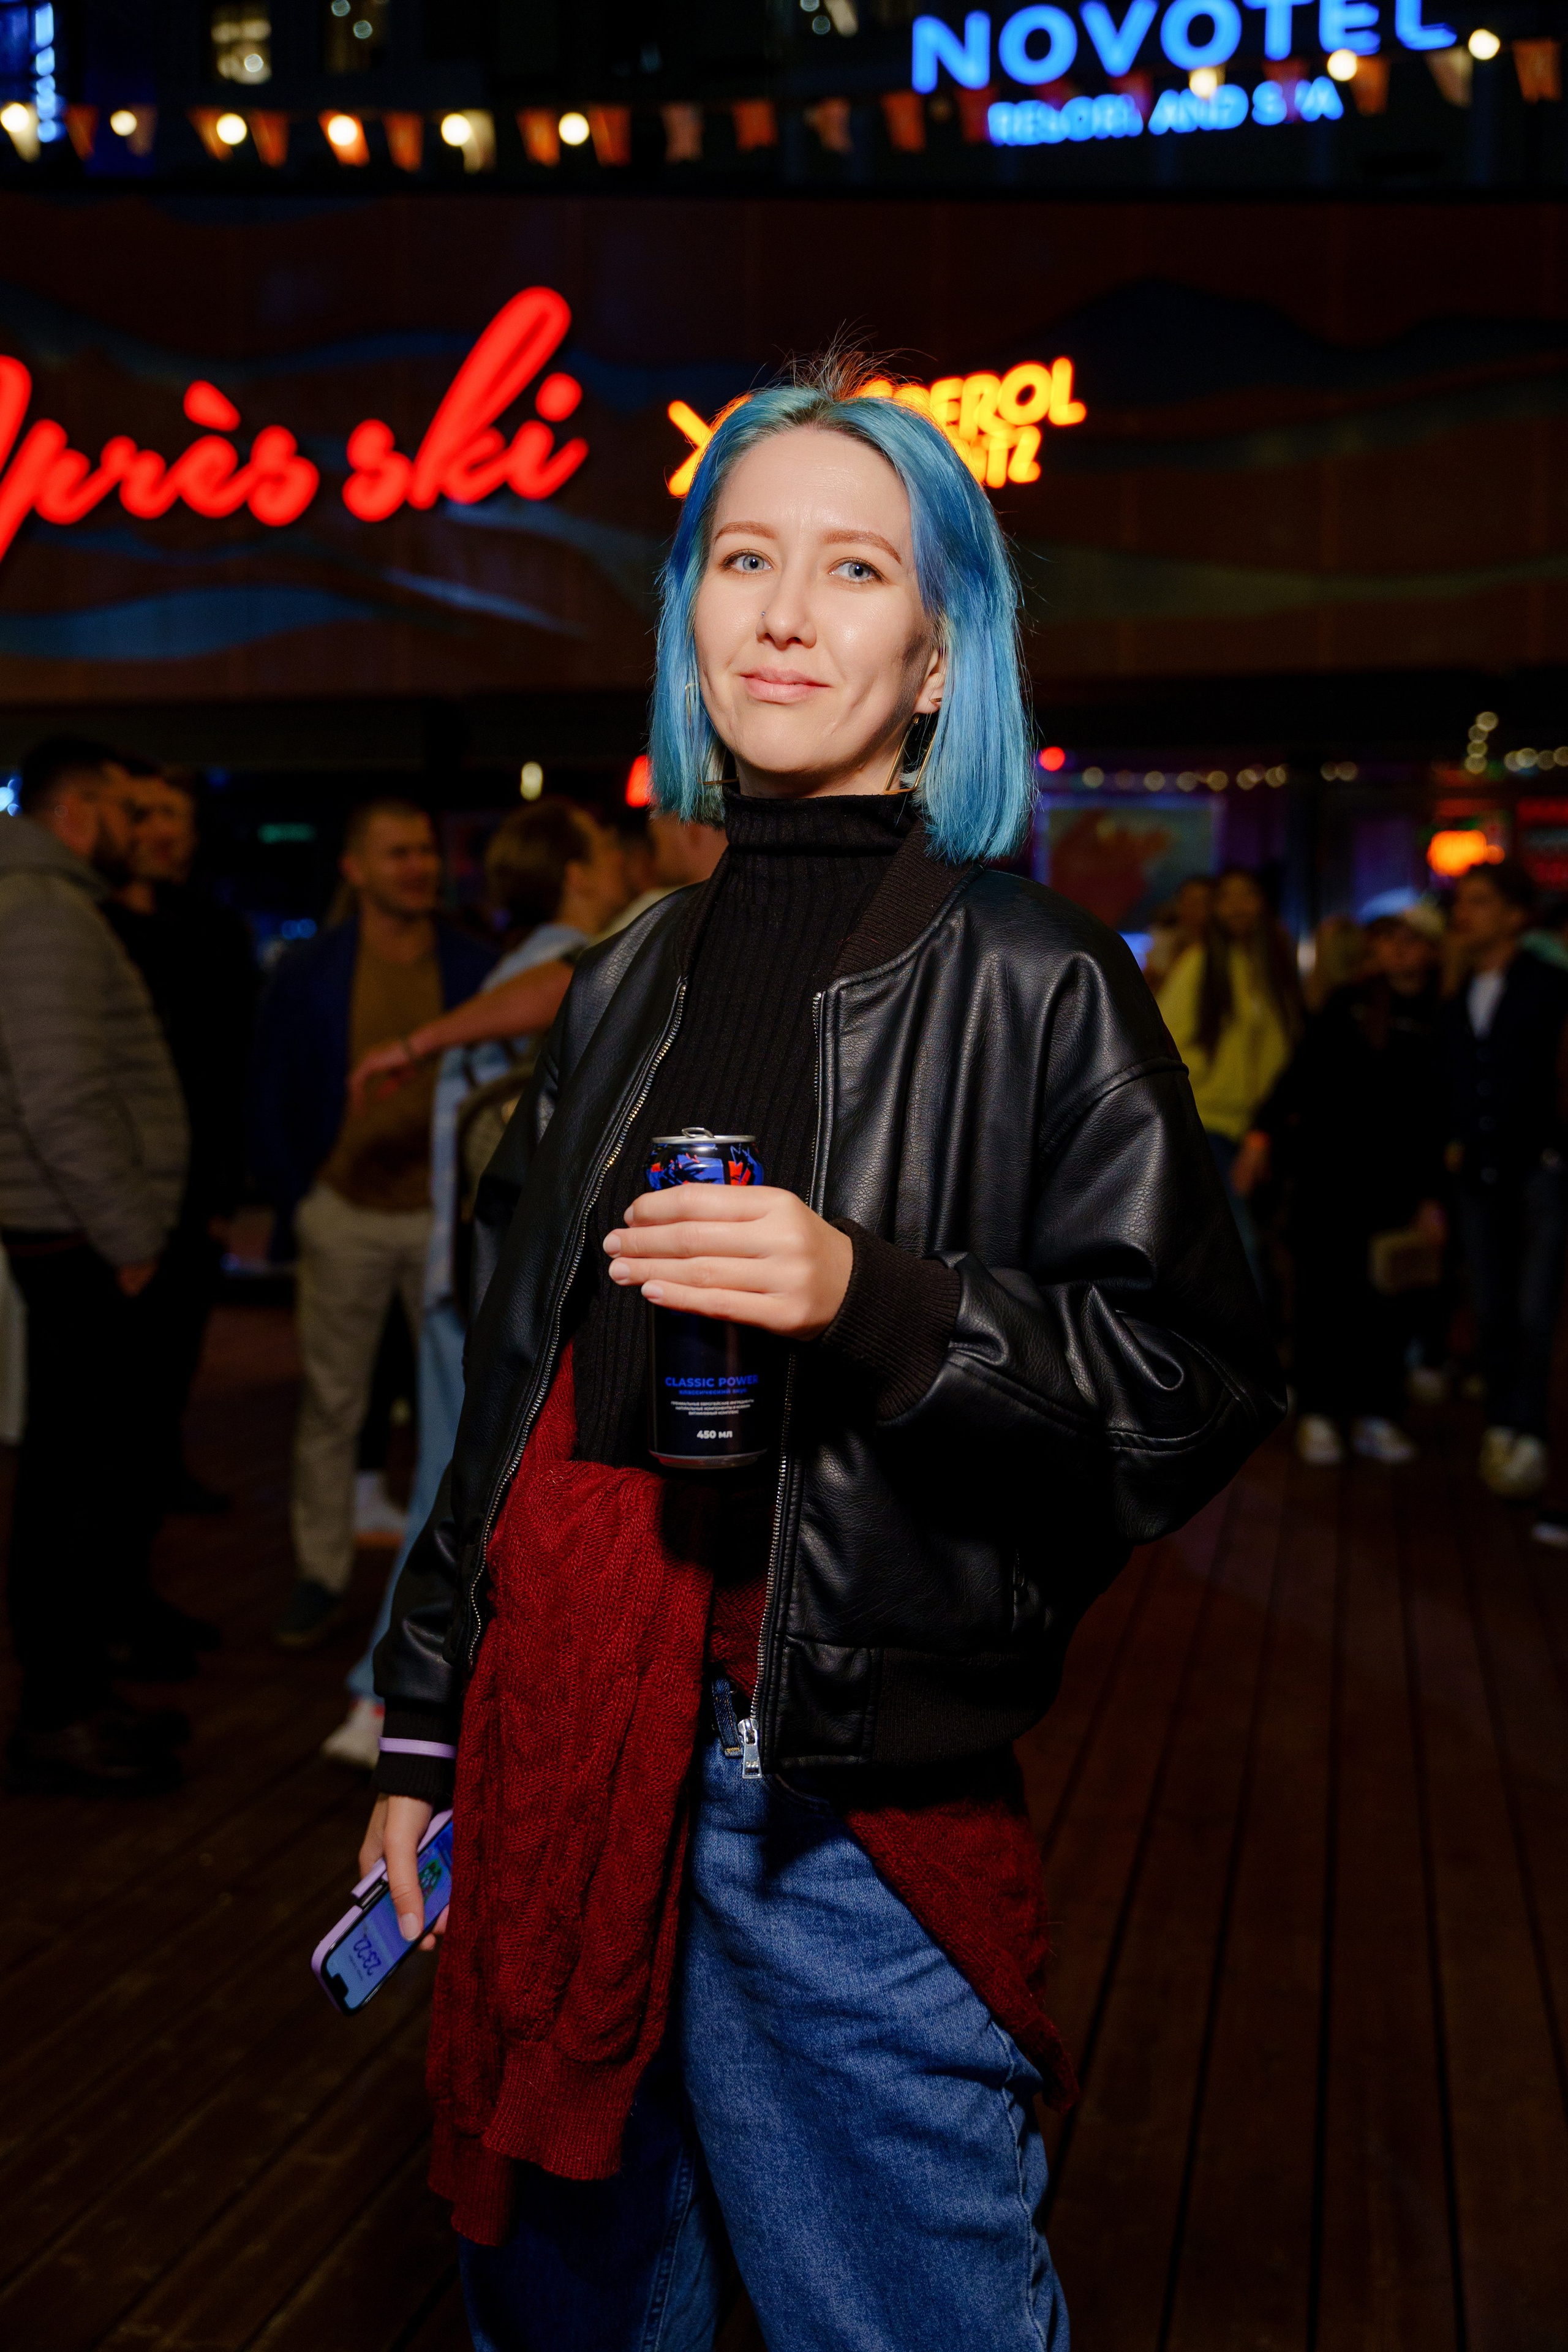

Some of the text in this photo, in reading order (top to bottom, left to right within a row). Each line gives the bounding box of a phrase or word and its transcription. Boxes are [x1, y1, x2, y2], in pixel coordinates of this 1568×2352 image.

[911, 0, 1457, 93] NOVOTEL
[1148, 84, 1248, 135] AND
[0, 285, 589, 562] près ski
[665, 1374, 758, 1387] CLASSIC POWER
[696, 1430, 717, 1439] 450
